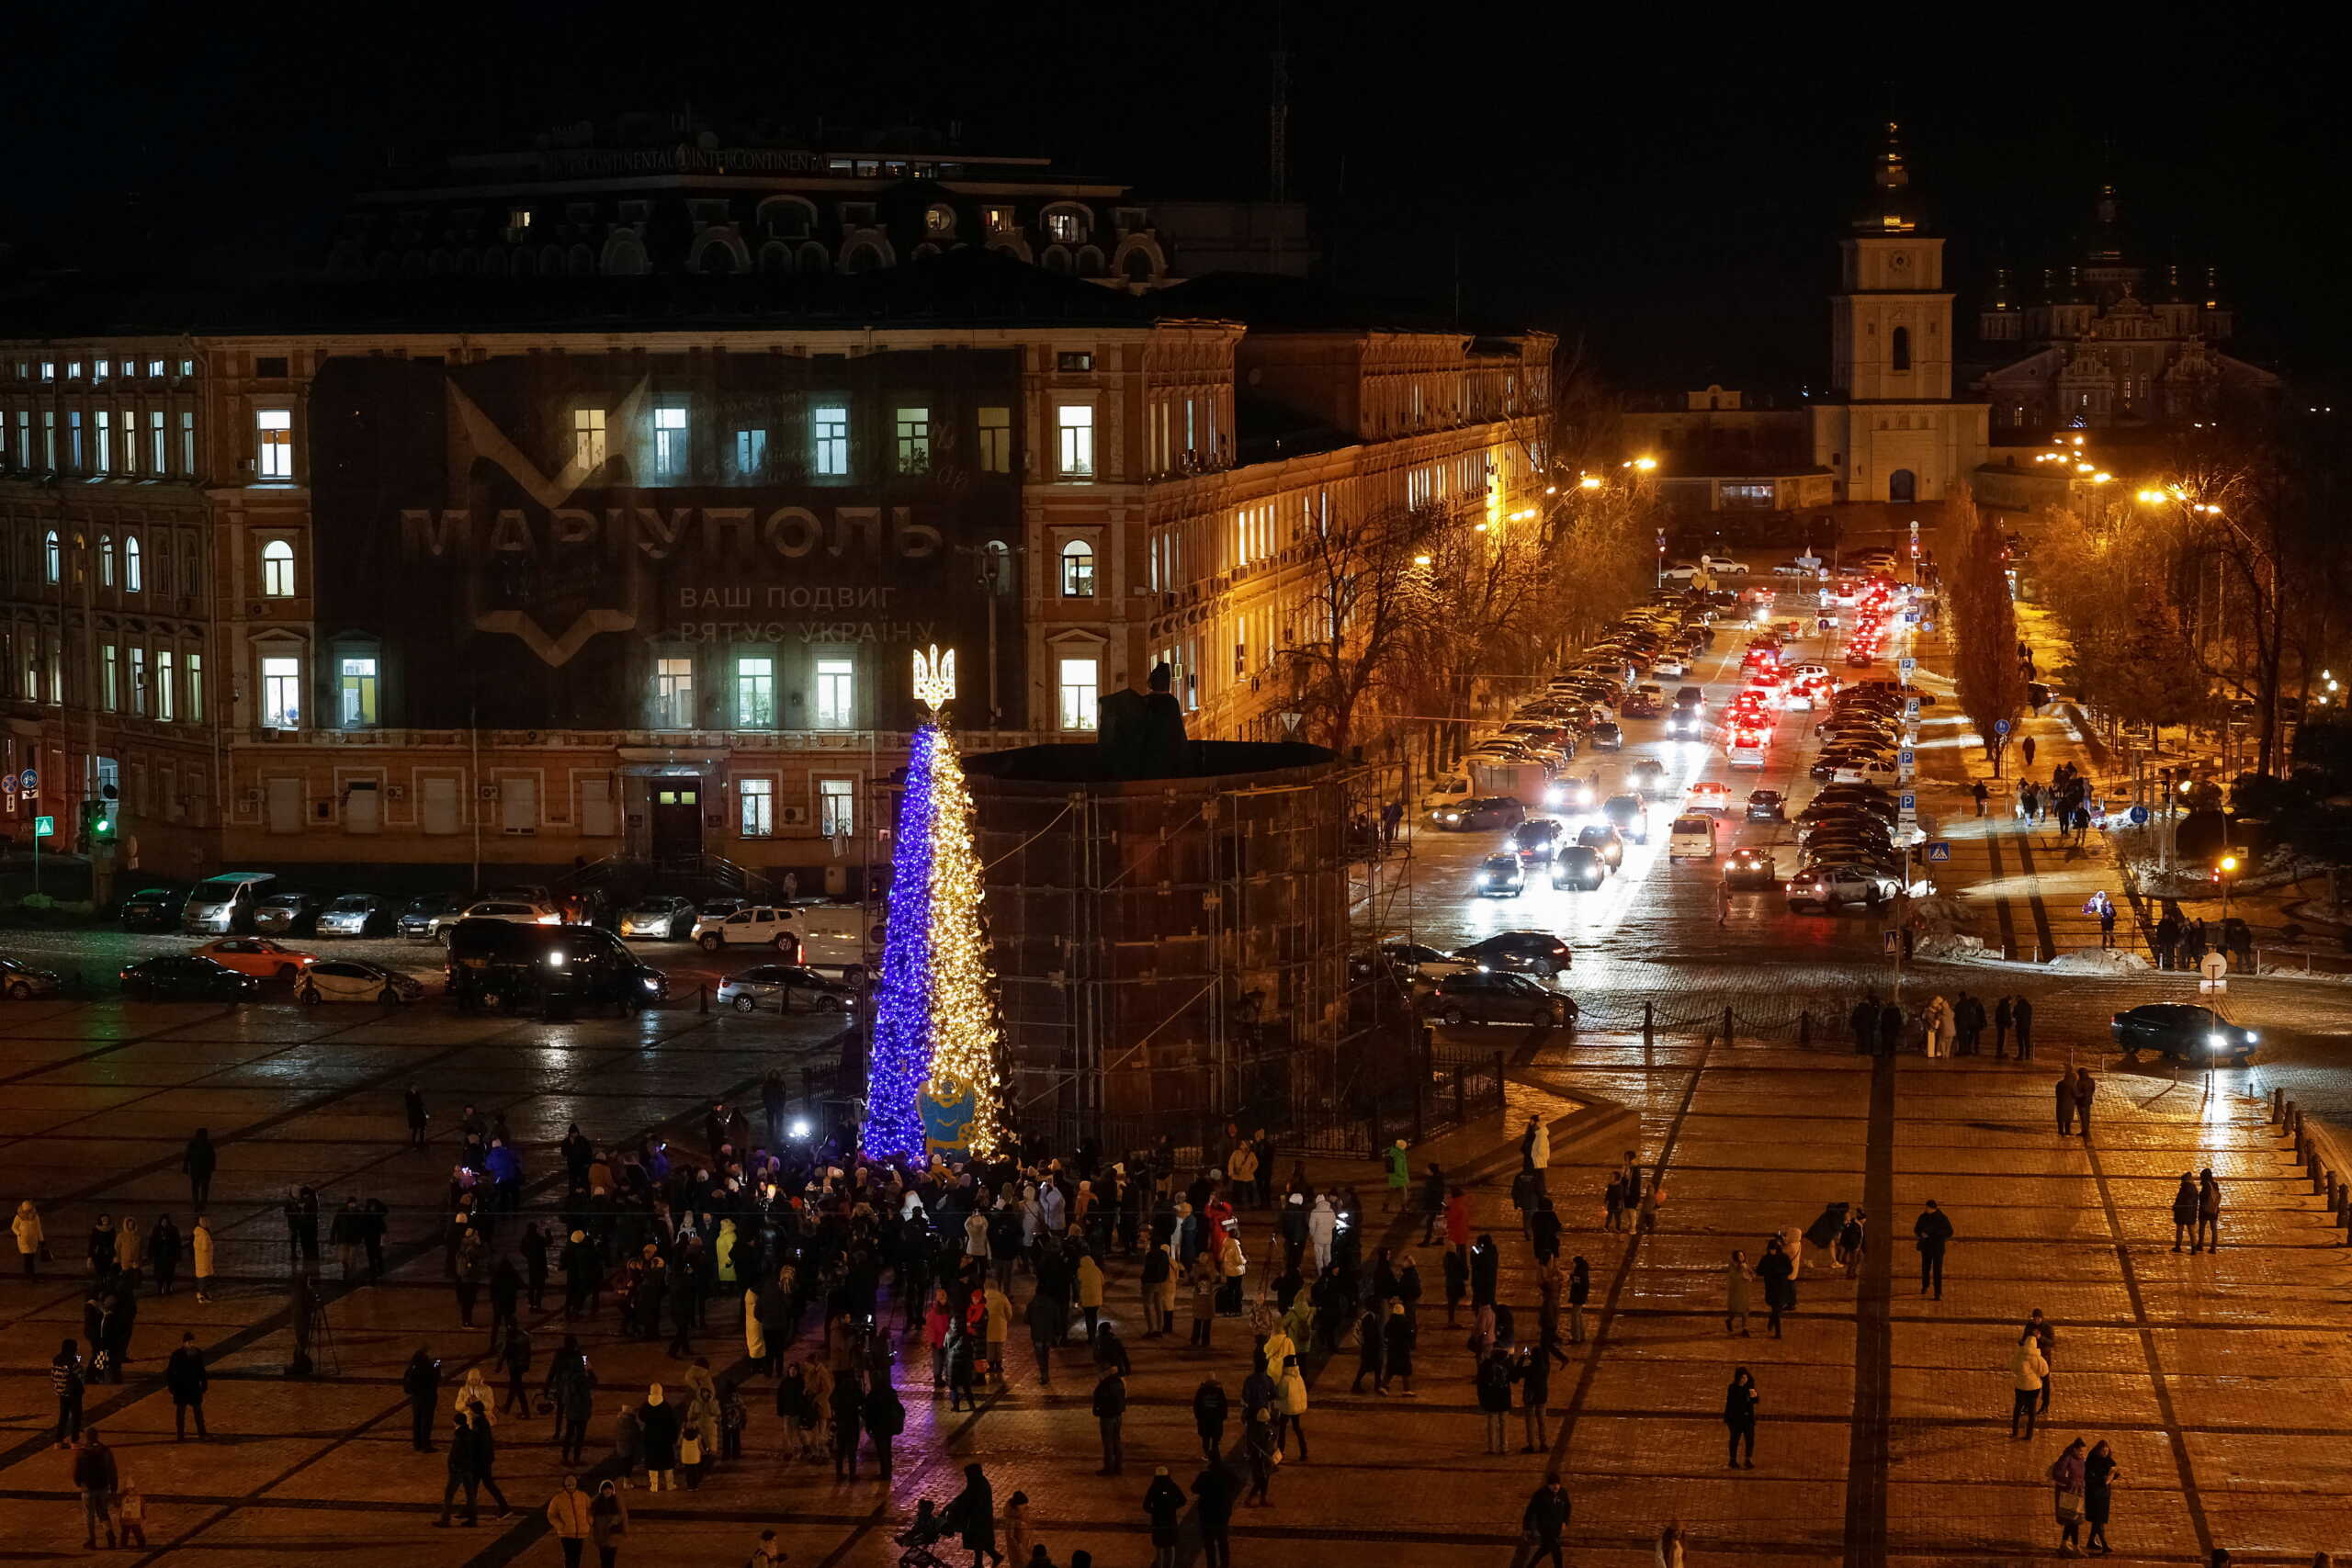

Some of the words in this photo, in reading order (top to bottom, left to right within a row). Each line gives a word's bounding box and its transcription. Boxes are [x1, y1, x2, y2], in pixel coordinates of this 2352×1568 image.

[401, 505, 944, 559] МАРІУПОЛЬ
[680, 587, 752, 608] ВАШ
[767, 587, 897, 612] ПОДВИГ
[680, 622, 786, 643] РЯТУЄ
[799, 616, 935, 644] УКРАЇНУ
